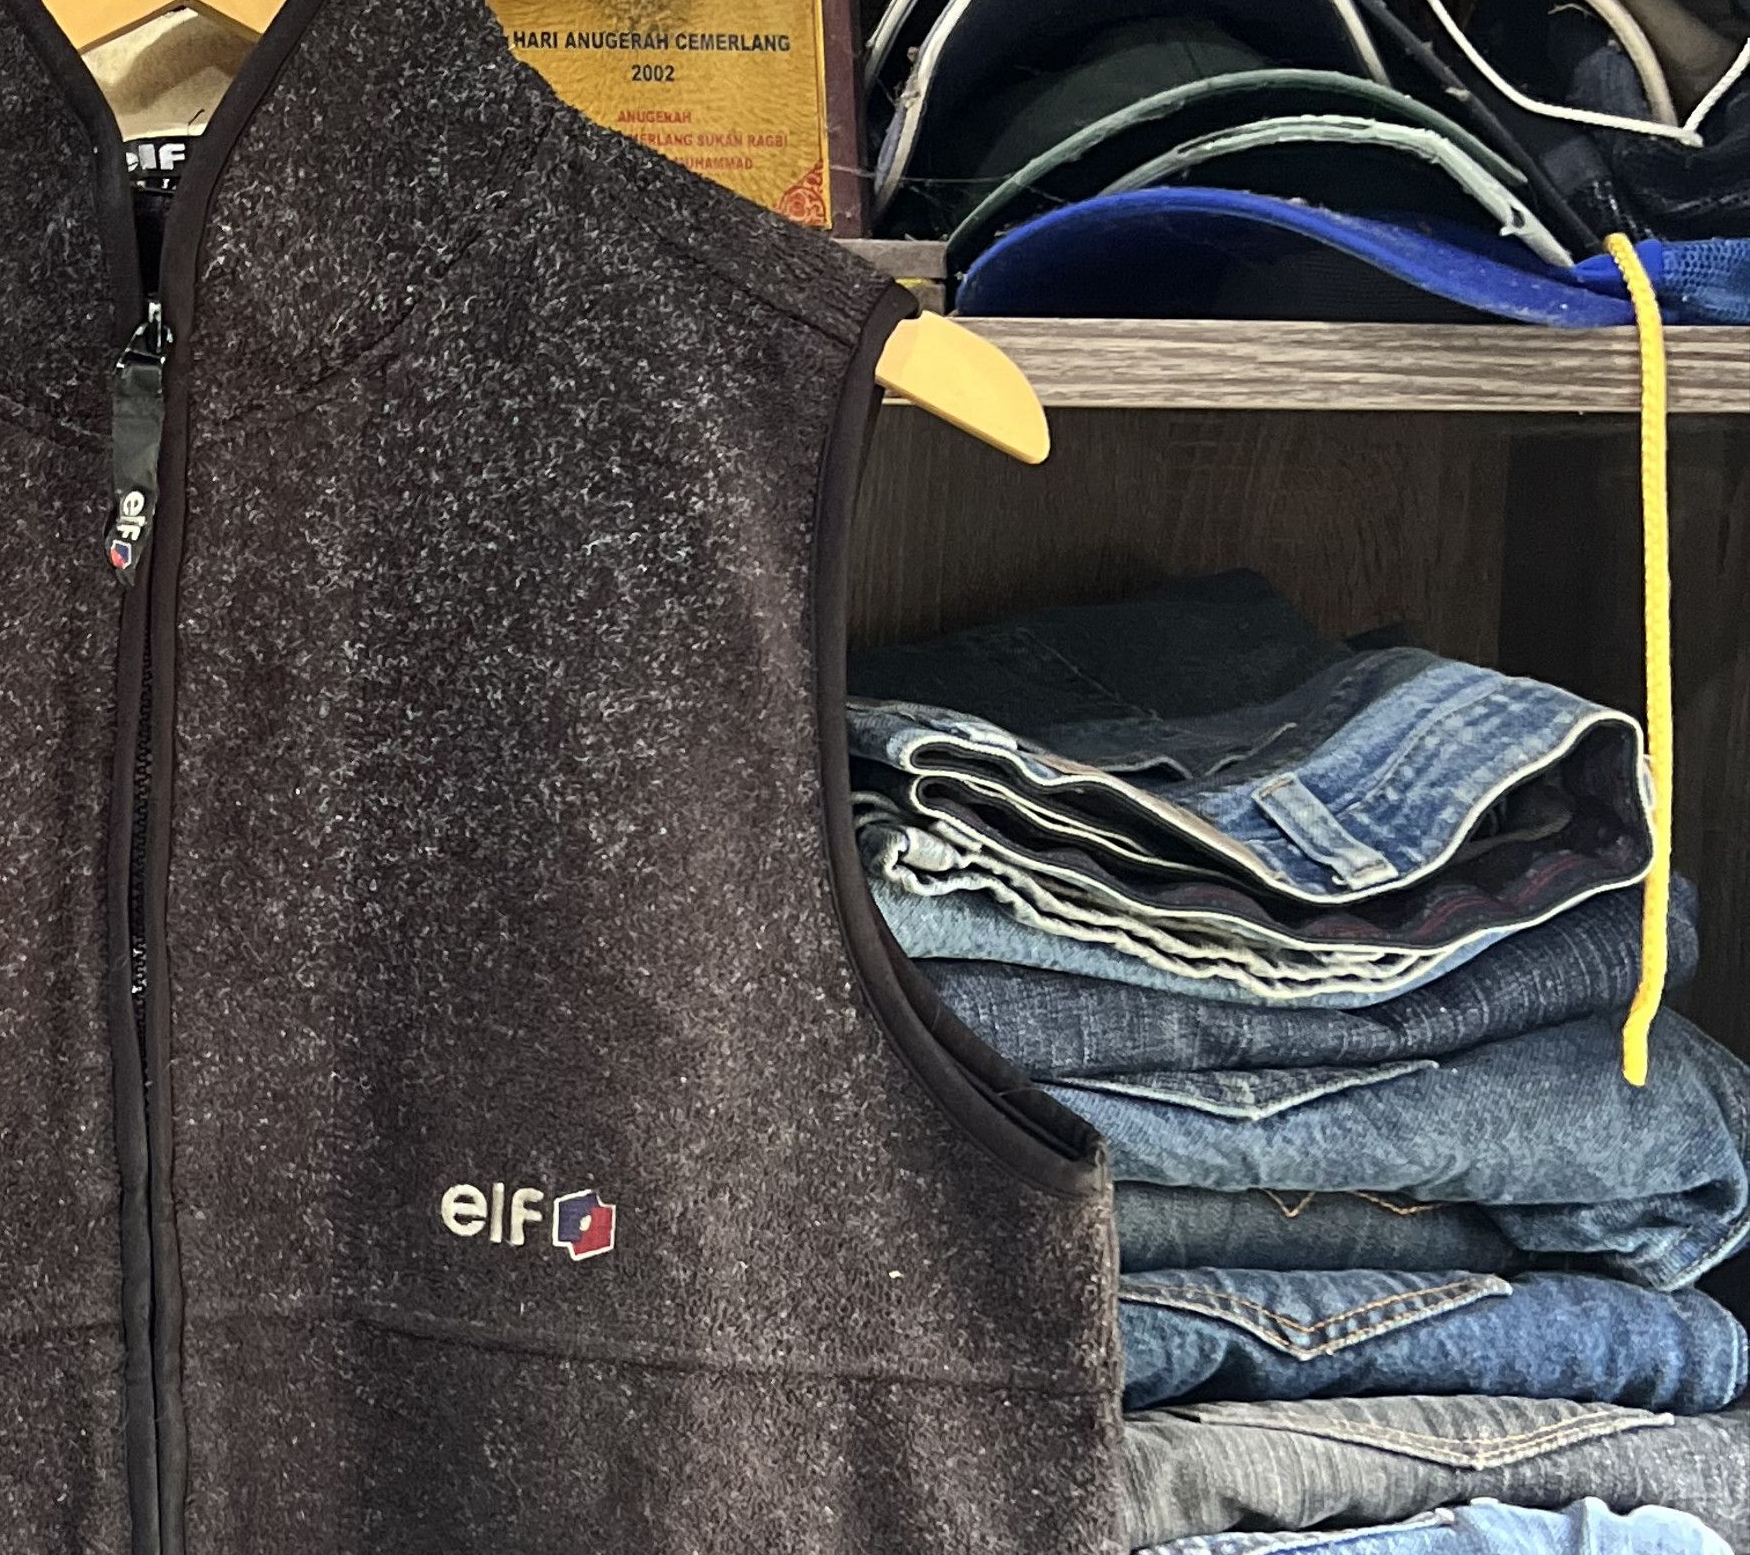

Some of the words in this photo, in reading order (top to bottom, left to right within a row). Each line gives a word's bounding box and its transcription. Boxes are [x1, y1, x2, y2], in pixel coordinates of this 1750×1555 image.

[513, 30, 558, 49] HARI
[565, 30, 669, 51] ANUGERAH
[675, 32, 791, 52] CEMERLANG
[631, 64, 675, 82] 2002
[617, 110, 692, 124] ANUGERAH
[697, 133, 743, 148] SUKAN
[746, 134, 788, 149] RAGBI
[116, 490, 147, 541] elf
[441, 1182, 545, 1246] elf
